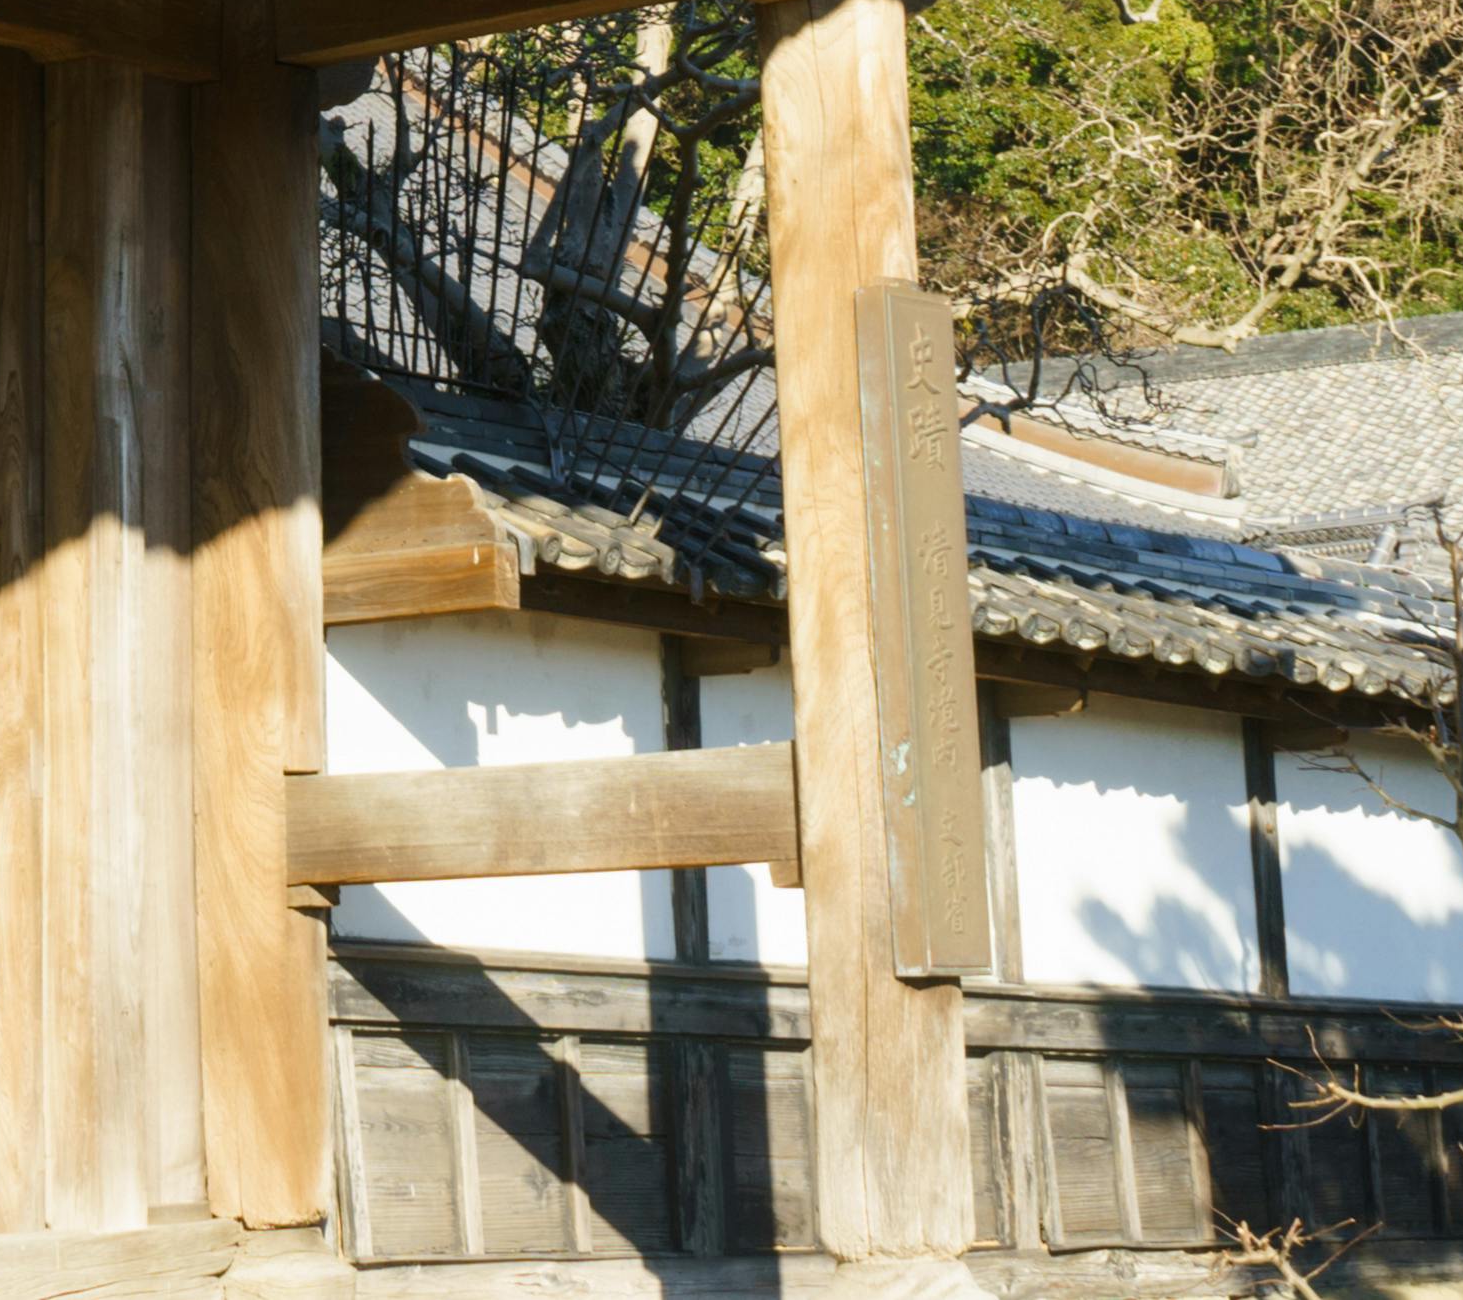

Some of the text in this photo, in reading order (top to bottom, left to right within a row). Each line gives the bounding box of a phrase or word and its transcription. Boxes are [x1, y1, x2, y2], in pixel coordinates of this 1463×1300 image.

[907, 321, 948, 472] 史蹟
[938, 807, 968, 935] 文部省
